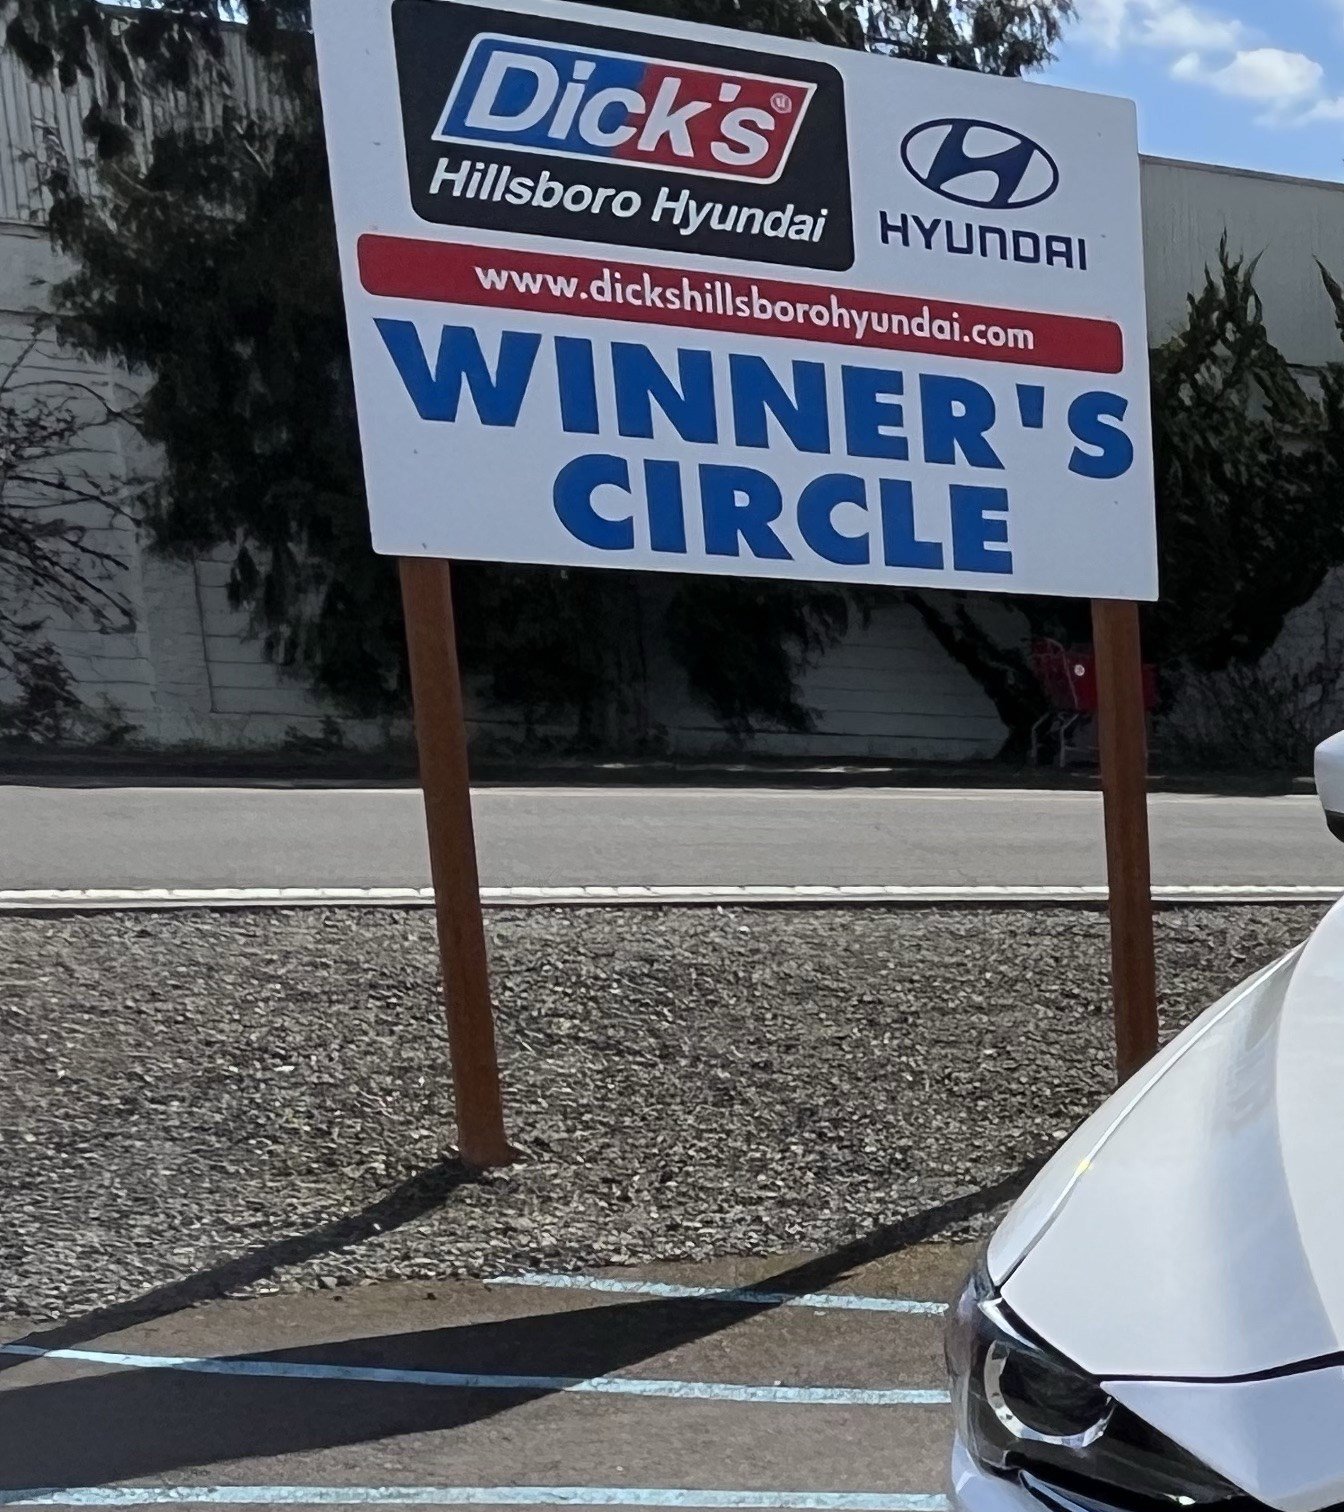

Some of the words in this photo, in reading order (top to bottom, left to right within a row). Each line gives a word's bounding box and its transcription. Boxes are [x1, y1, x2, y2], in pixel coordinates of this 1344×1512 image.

[464, 50, 775, 167] Dick's
[429, 157, 641, 218] Hillsboro
[651, 187, 829, 243] Hyundai
[879, 211, 1087, 271] HYUNDAI
[473, 264, 1035, 352] www.dickshillsborohyundai.com
[373, 318, 1135, 479] WINNER'S
[553, 453, 1014, 575] CIRCLE
